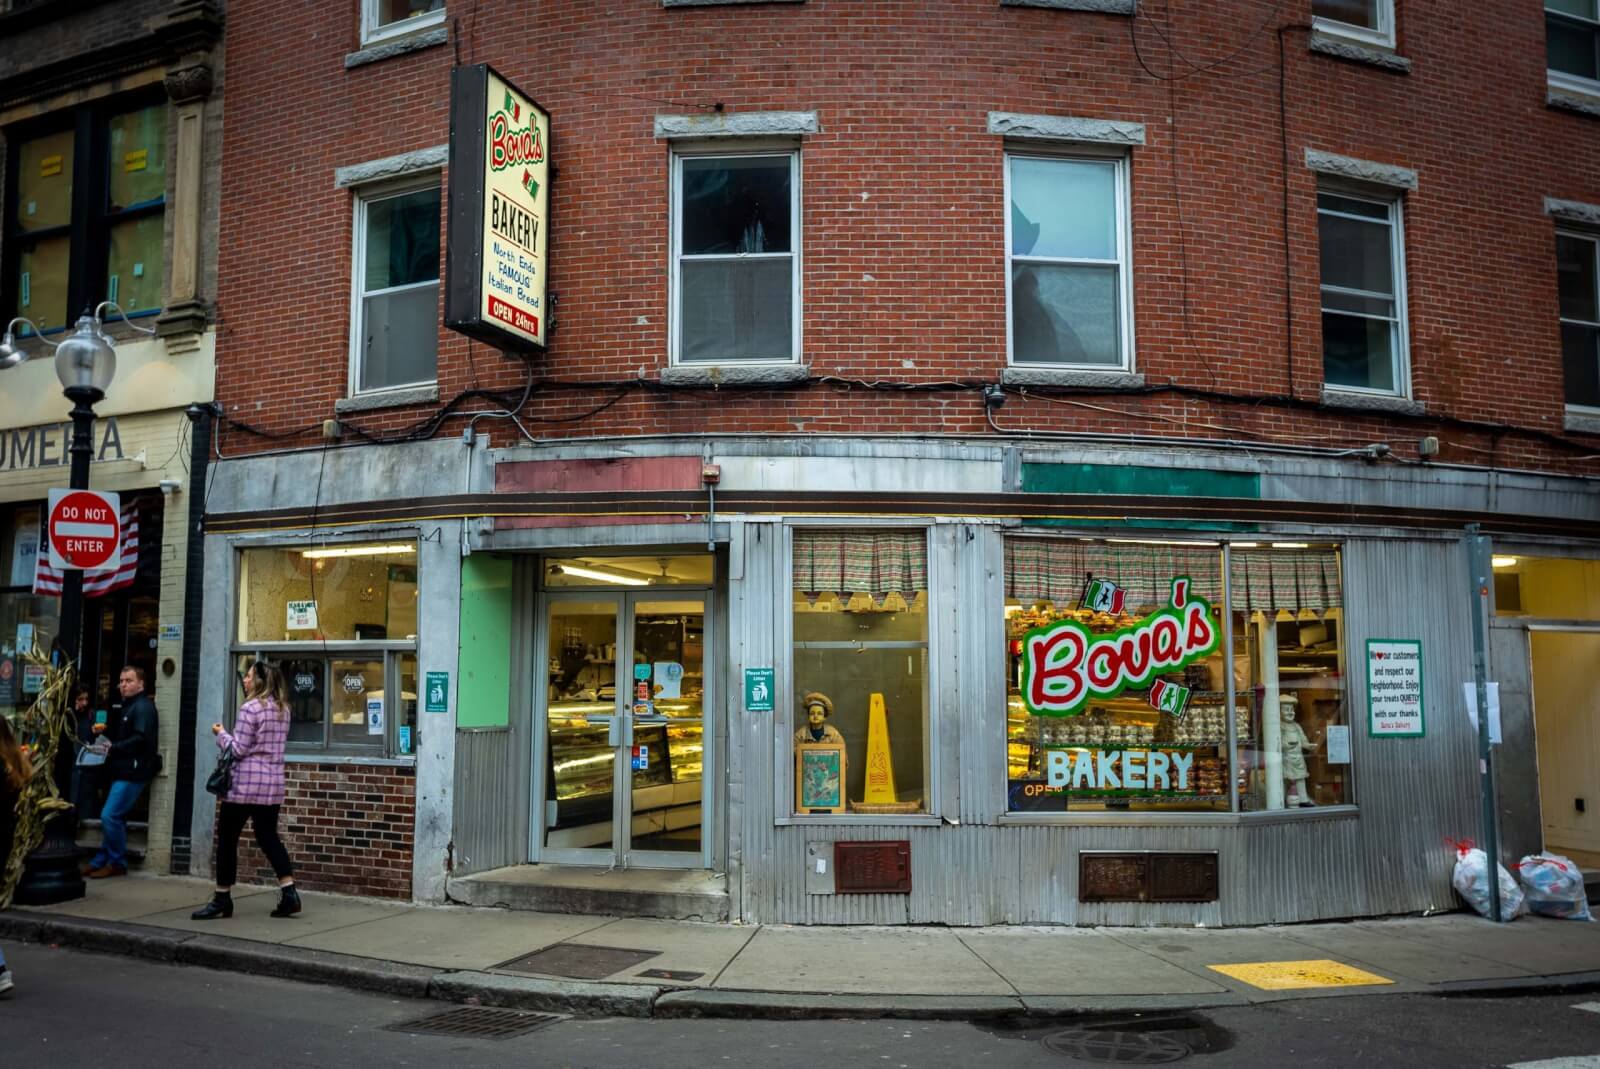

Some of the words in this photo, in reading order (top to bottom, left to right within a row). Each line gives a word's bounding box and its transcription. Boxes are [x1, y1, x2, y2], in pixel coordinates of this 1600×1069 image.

[490, 112, 544, 170] Bova's
[492, 194, 539, 253] BAKERY
[493, 242, 516, 263] North
[488, 272, 513, 295] Italian
[517, 287, 540, 308] Bread
[493, 302, 513, 322] OPEN
[515, 314, 535, 333] 24hrs
[62, 506, 79, 519] DO
[84, 508, 108, 520] NOT
[66, 539, 104, 552] ENTER
[1029, 578, 1214, 709] Bova's
[1375, 667, 1384, 676] and
[1385, 667, 1404, 677] respect
[297, 676, 312, 685] OPEN
[346, 678, 361, 687] OPEN
[1406, 681, 1419, 692] Enjoy
[1383, 695, 1400, 703] treats
[1375, 709, 1387, 718] with
[1047, 750, 1193, 789] BAKERY
